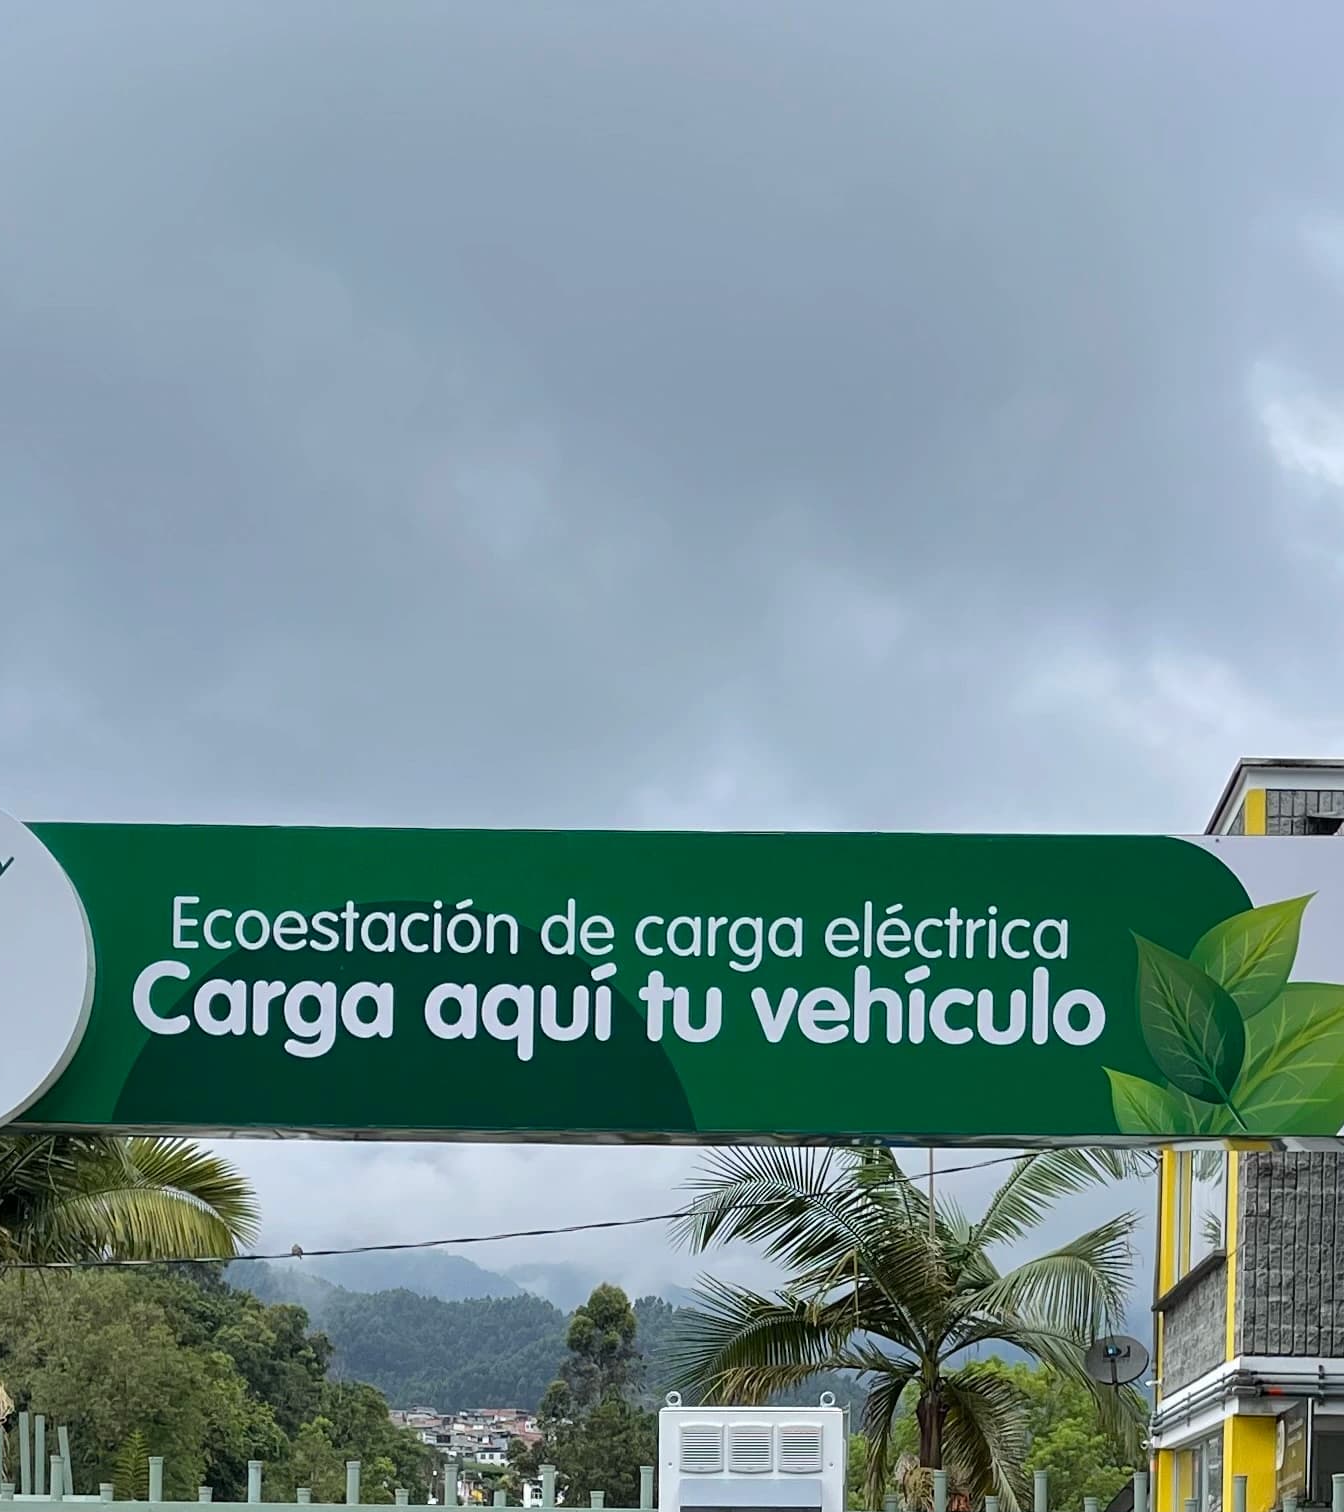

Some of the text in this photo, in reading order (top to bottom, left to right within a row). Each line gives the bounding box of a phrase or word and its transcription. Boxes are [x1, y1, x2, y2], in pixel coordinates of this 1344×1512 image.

[172, 896, 1068, 972] Ecoestación de carga eléctrica
[132, 960, 1106, 1061] Carga aquí tu vehículo
